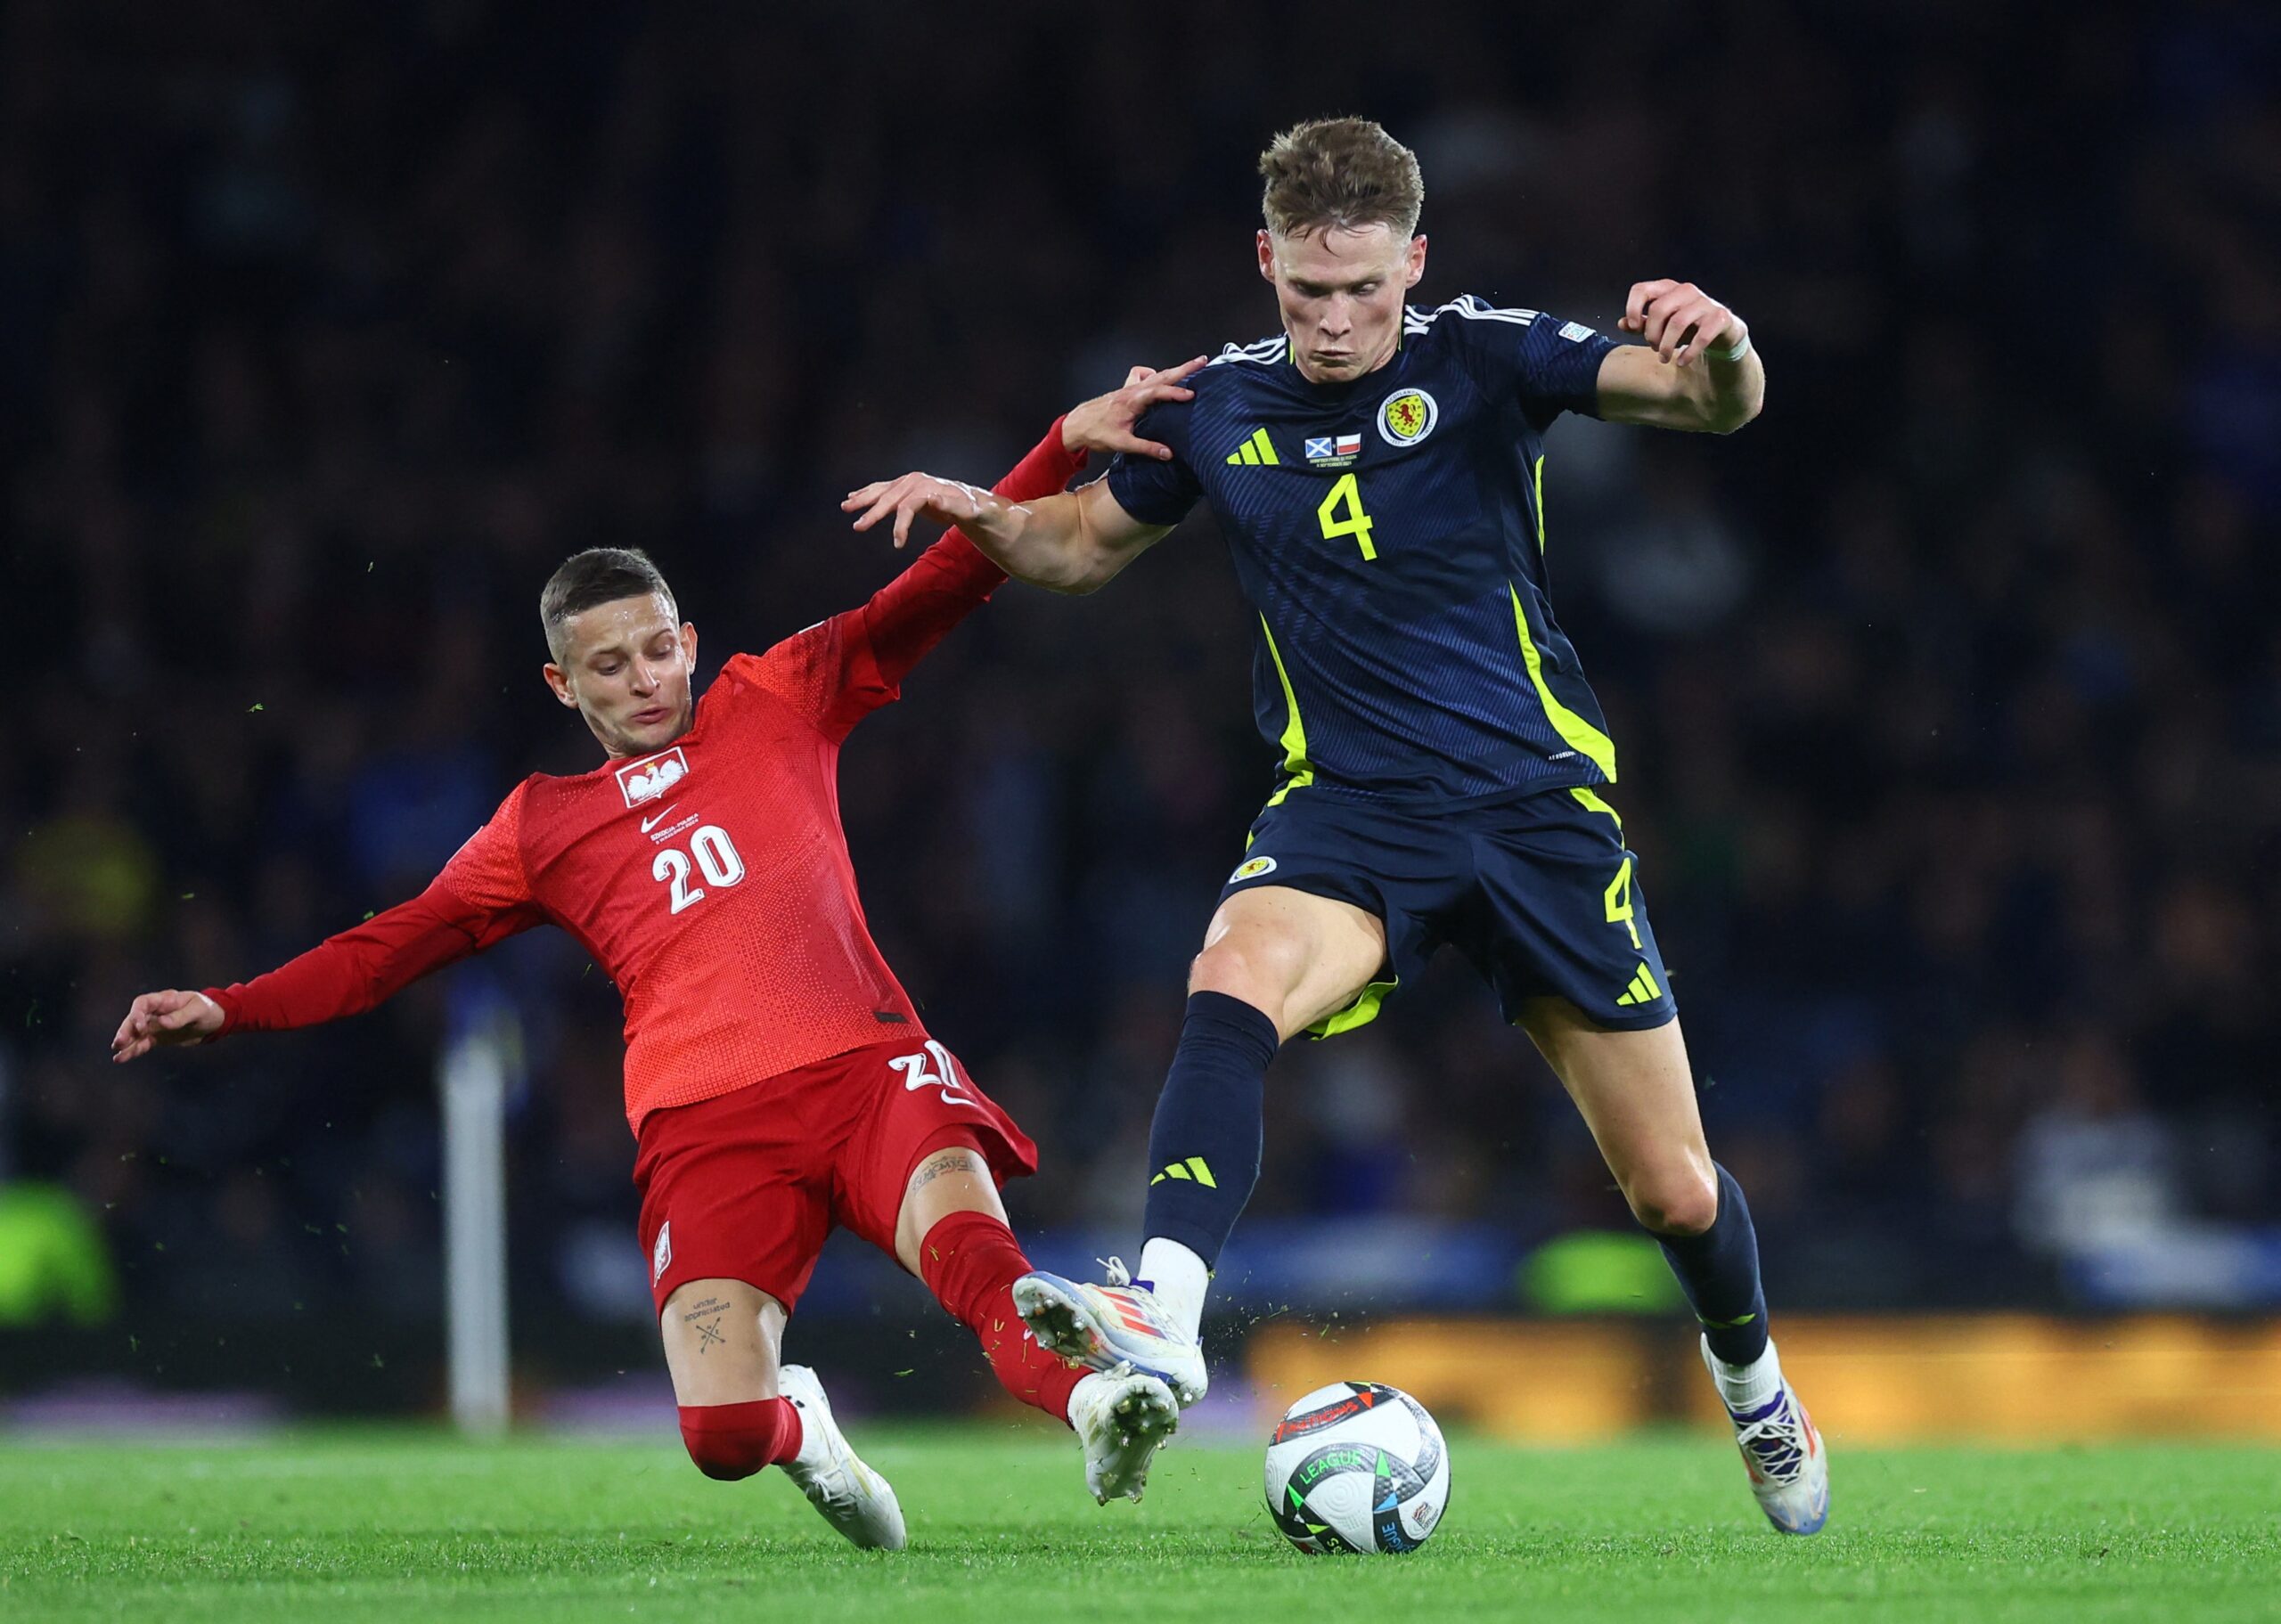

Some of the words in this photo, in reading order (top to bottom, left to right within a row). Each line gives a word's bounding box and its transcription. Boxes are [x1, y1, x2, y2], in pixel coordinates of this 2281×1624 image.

[1317, 472, 1378, 561] 4
[652, 825, 745, 915] 20
[1604, 857, 1642, 950] 4
[1286, 1400, 1359, 1435] NATIONS
[1299, 1449, 1362, 1485] LEAGUE
